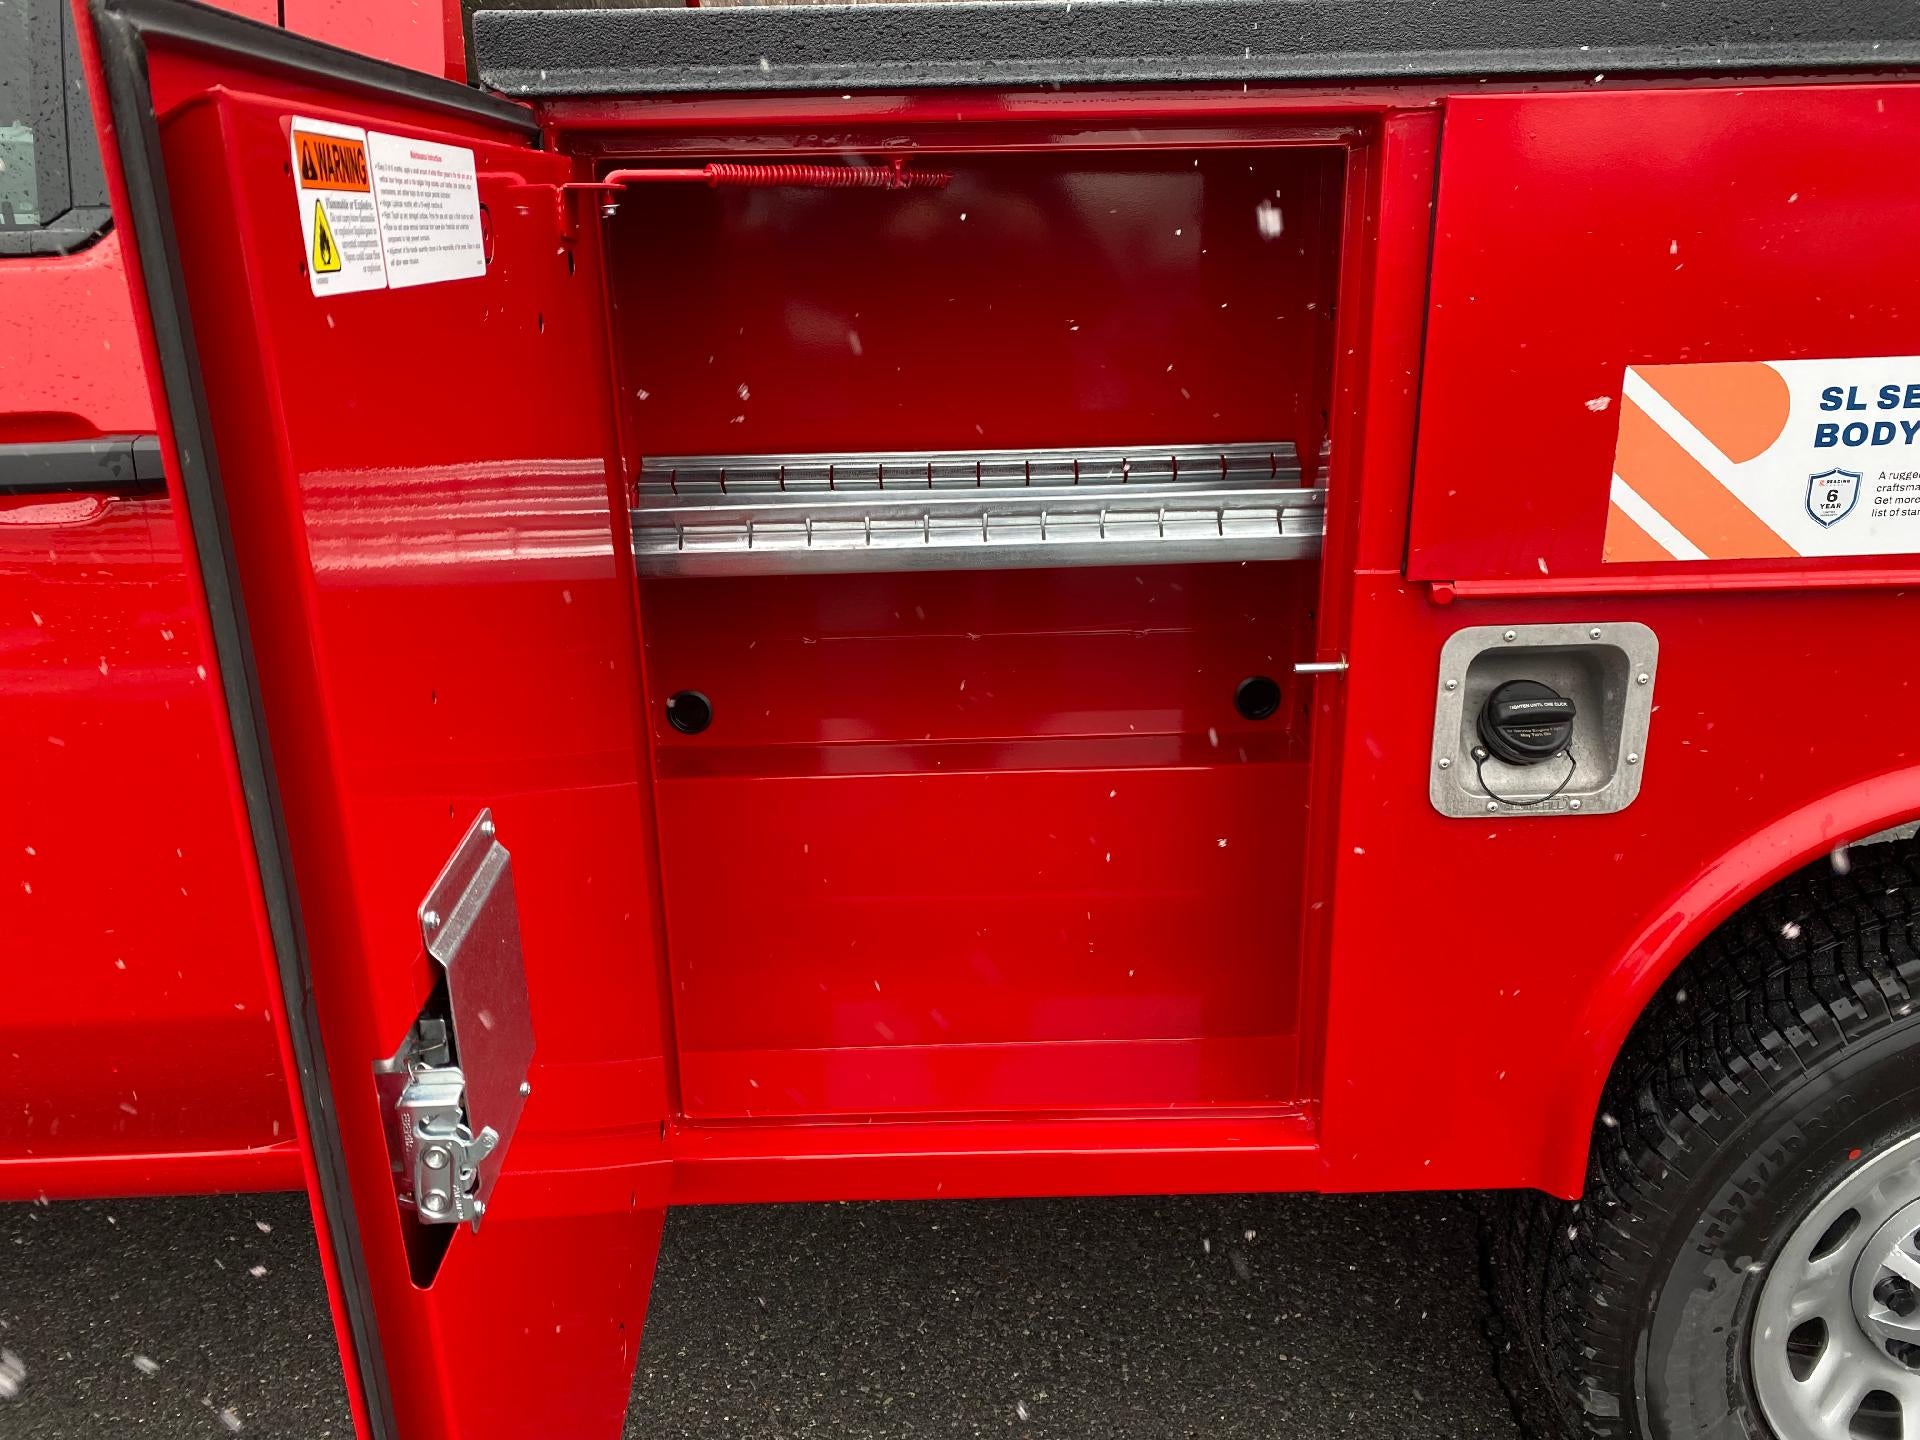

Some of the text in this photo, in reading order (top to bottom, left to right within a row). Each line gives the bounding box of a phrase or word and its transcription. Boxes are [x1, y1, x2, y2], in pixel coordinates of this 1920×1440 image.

[313, 141, 367, 185] WARNING
[1820, 386, 1867, 411] SL
[1814, 420, 1920, 448] BODY
[1878, 471, 1920, 480] A rugge
[1827, 490, 1838, 502] 6
[1874, 496, 1892, 504] Get
[1872, 508, 1887, 517] list
[1889, 508, 1900, 516] of
